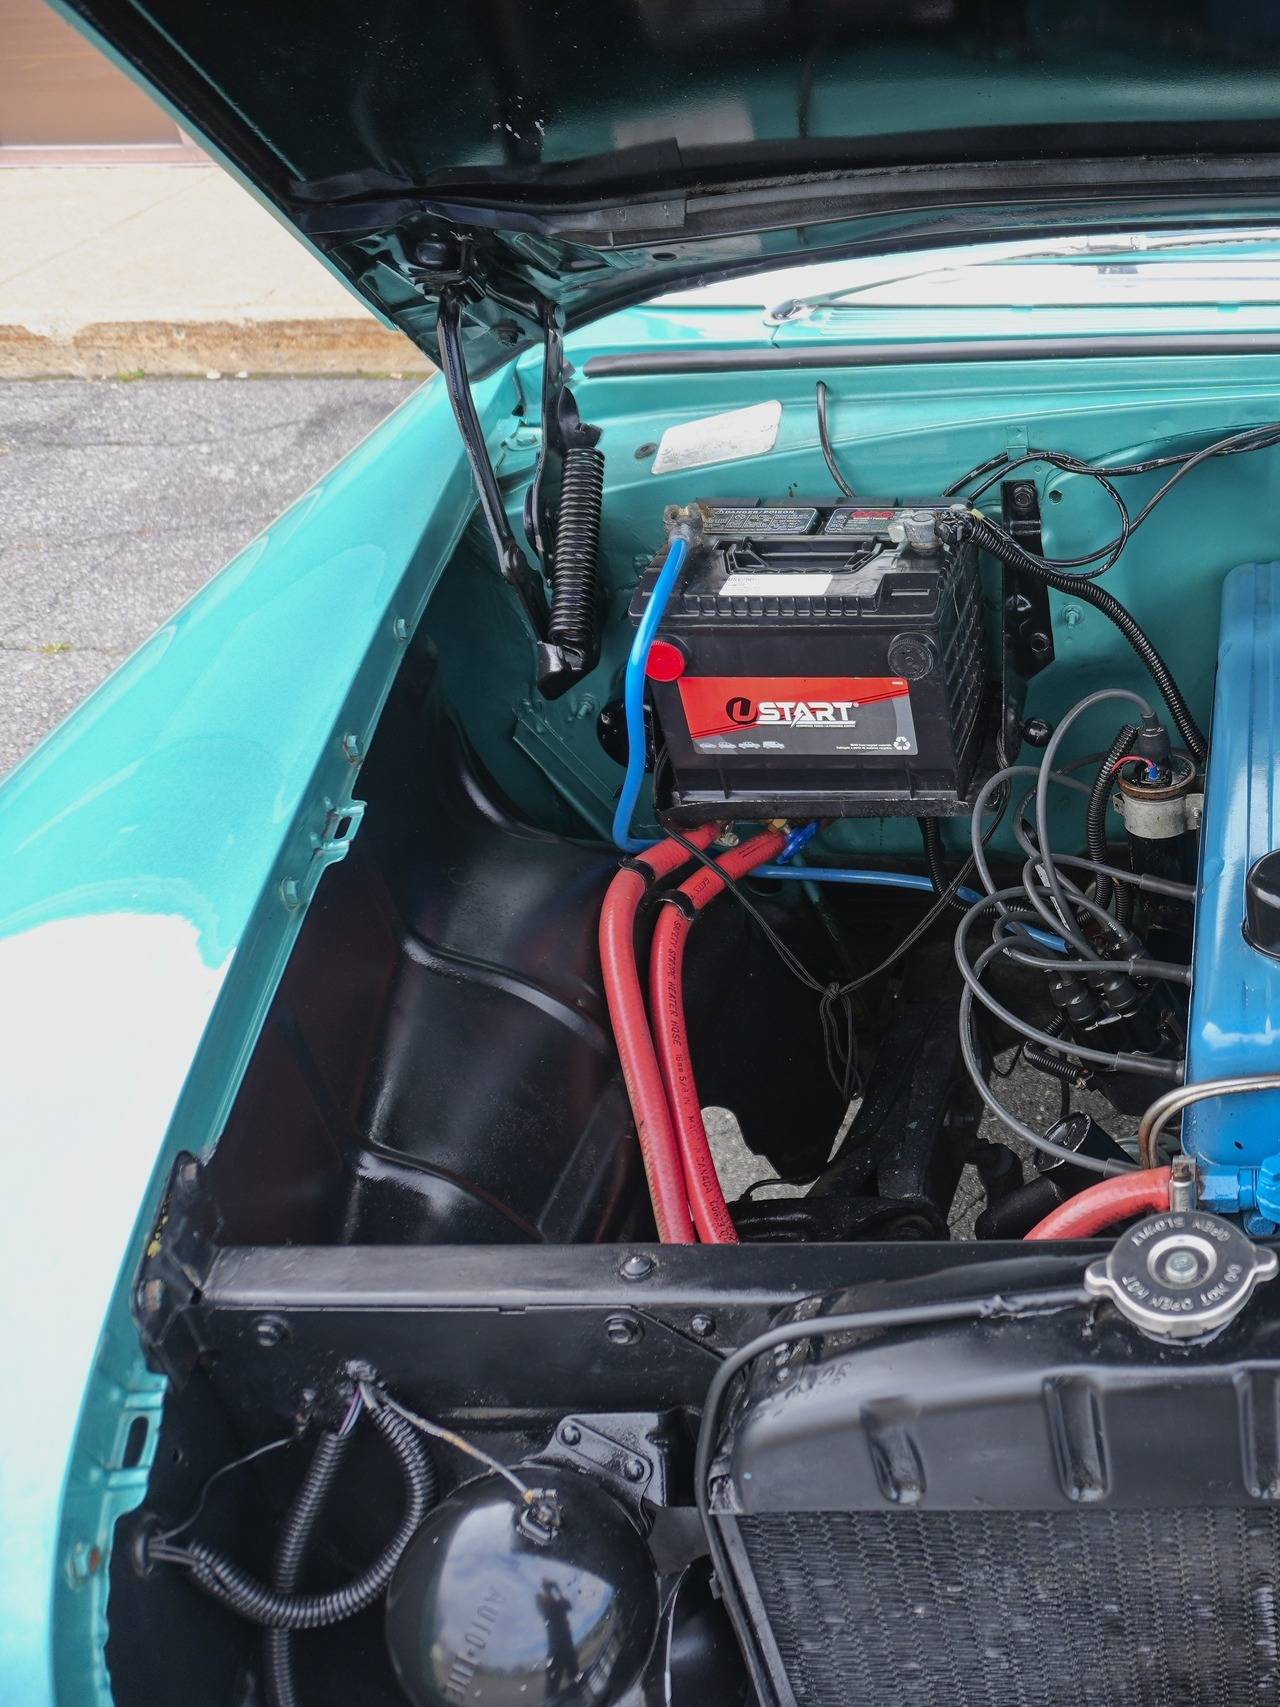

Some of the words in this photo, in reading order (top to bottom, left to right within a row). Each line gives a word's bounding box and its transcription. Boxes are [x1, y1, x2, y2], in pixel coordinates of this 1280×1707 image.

[667, 981, 679, 1017] HEATER
[671, 1020, 682, 1047] HOSE
[696, 1155, 713, 1194] CANADA
[1191, 1218, 1231, 1242] OPEN
[1121, 1275, 1150, 1300] HOT
[1150, 1296, 1194, 1312] OPEN
[443, 1585, 505, 1700] AUTO-LITE
